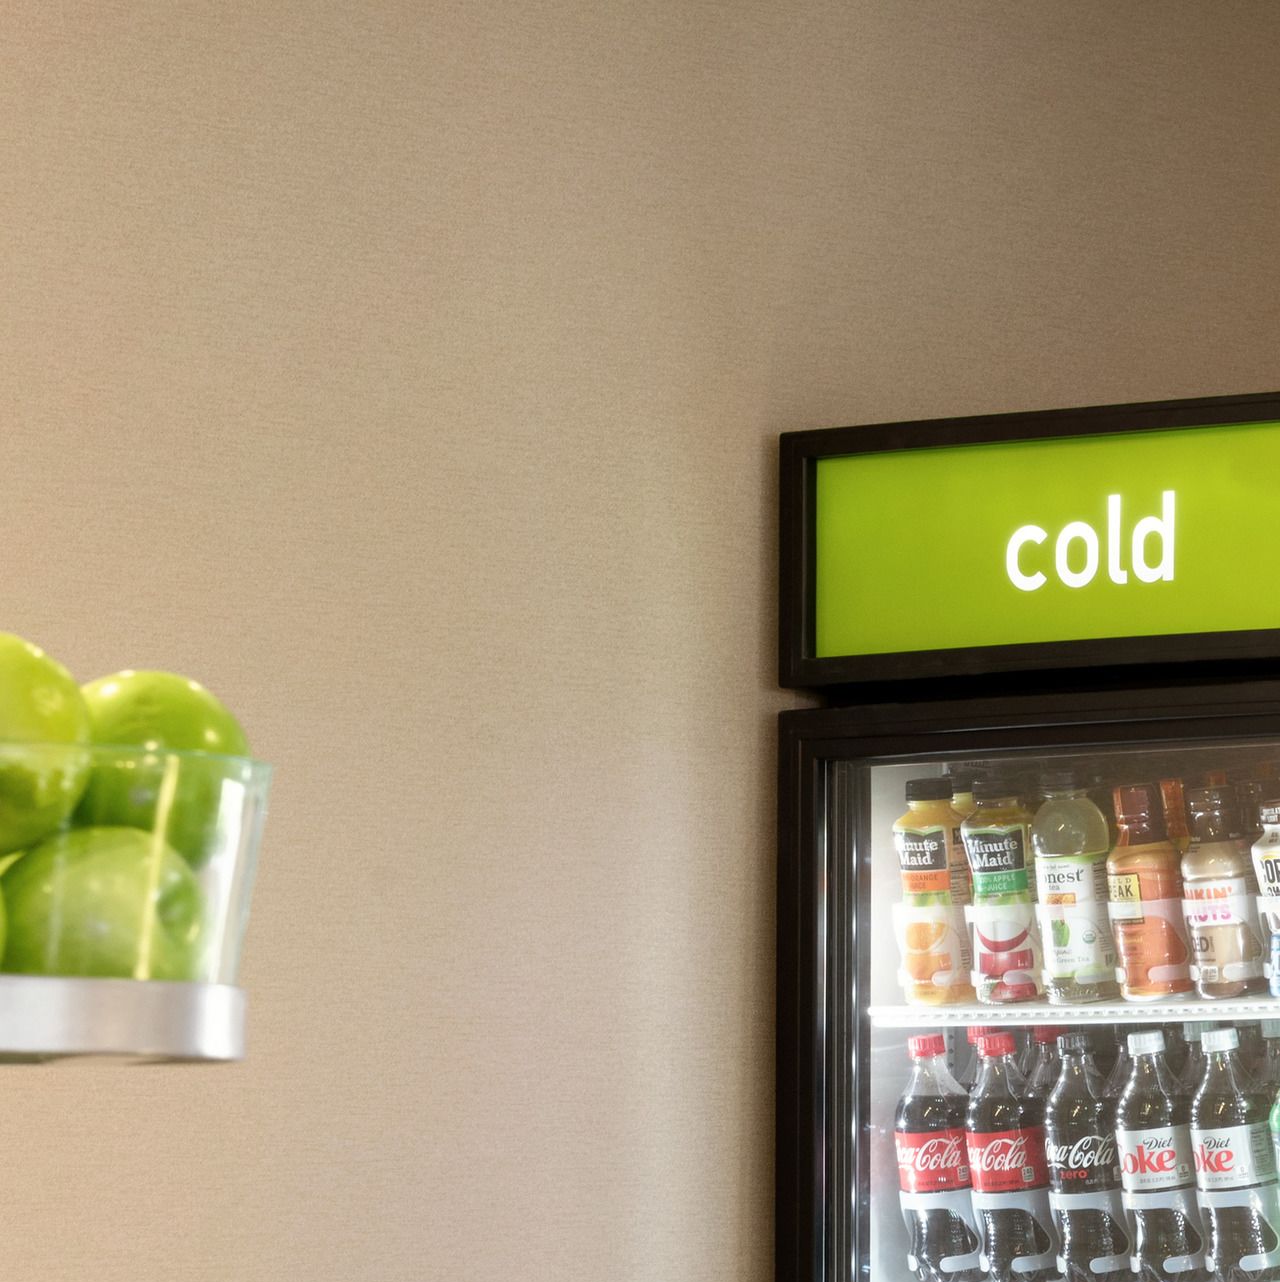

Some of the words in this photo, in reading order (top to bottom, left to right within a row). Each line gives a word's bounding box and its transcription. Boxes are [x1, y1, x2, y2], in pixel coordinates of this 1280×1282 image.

[1004, 488, 1176, 593] cold
[966, 839, 1018, 853] Minute
[900, 853, 933, 867] Maid
[974, 854, 1013, 868] Maid
[1142, 1136, 1173, 1149] Diet
[1203, 1136, 1230, 1149] Diet
[1060, 1169, 1088, 1179] zero
